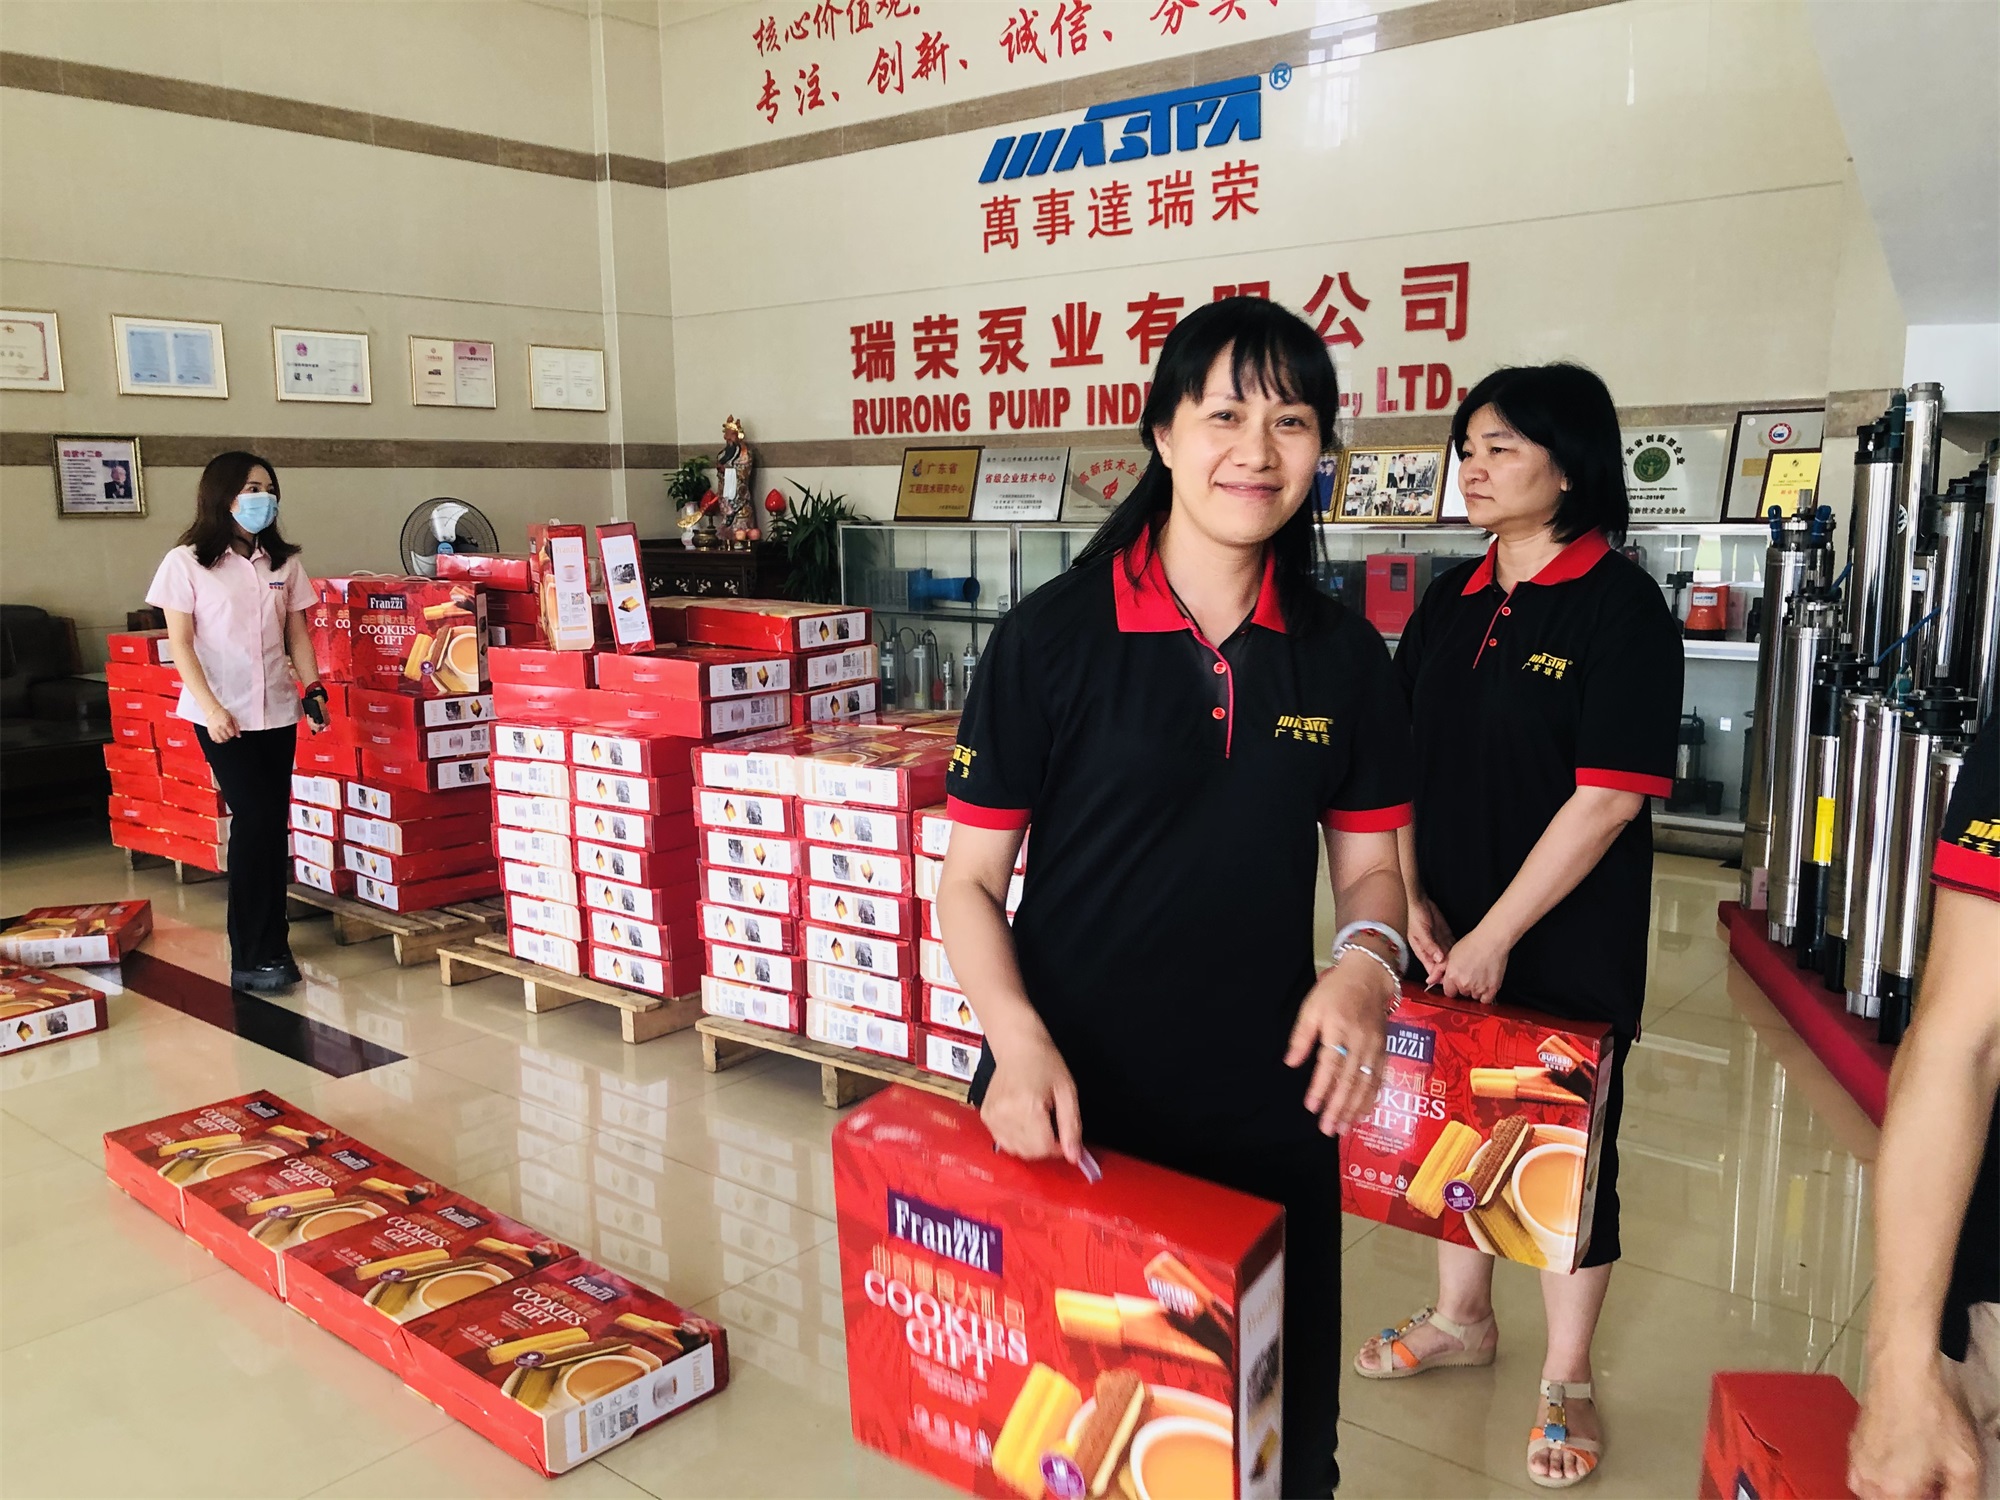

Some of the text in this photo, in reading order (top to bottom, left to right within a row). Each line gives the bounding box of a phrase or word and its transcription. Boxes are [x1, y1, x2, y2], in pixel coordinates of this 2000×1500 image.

[981, 159, 1261, 254] 萬事達瑞荣
[853, 392, 971, 435] RUIRONG
[989, 387, 1070, 430] PUMP
[926, 461, 958, 475] 广东省
[984, 472, 1057, 484] 省级企业技术中心
[370, 597, 404, 610] Franzzi
[359, 624, 416, 636] COOKIES
[374, 635, 404, 646] GIFT
[193, 1117, 223, 1132] GIFT
[200, 1108, 246, 1133] COOKIES
[278, 1168, 313, 1187] GIFT
[284, 1157, 338, 1188] COOKIES
[384, 1228, 423, 1248] GIFT
[386, 1215, 450, 1248] COOKIES
[566, 1275, 617, 1302] Franzzi
[512, 1301, 557, 1326] GIFT
[513, 1286, 588, 1326] COOKIES
[864, 1269, 1029, 1367] COOKIES
